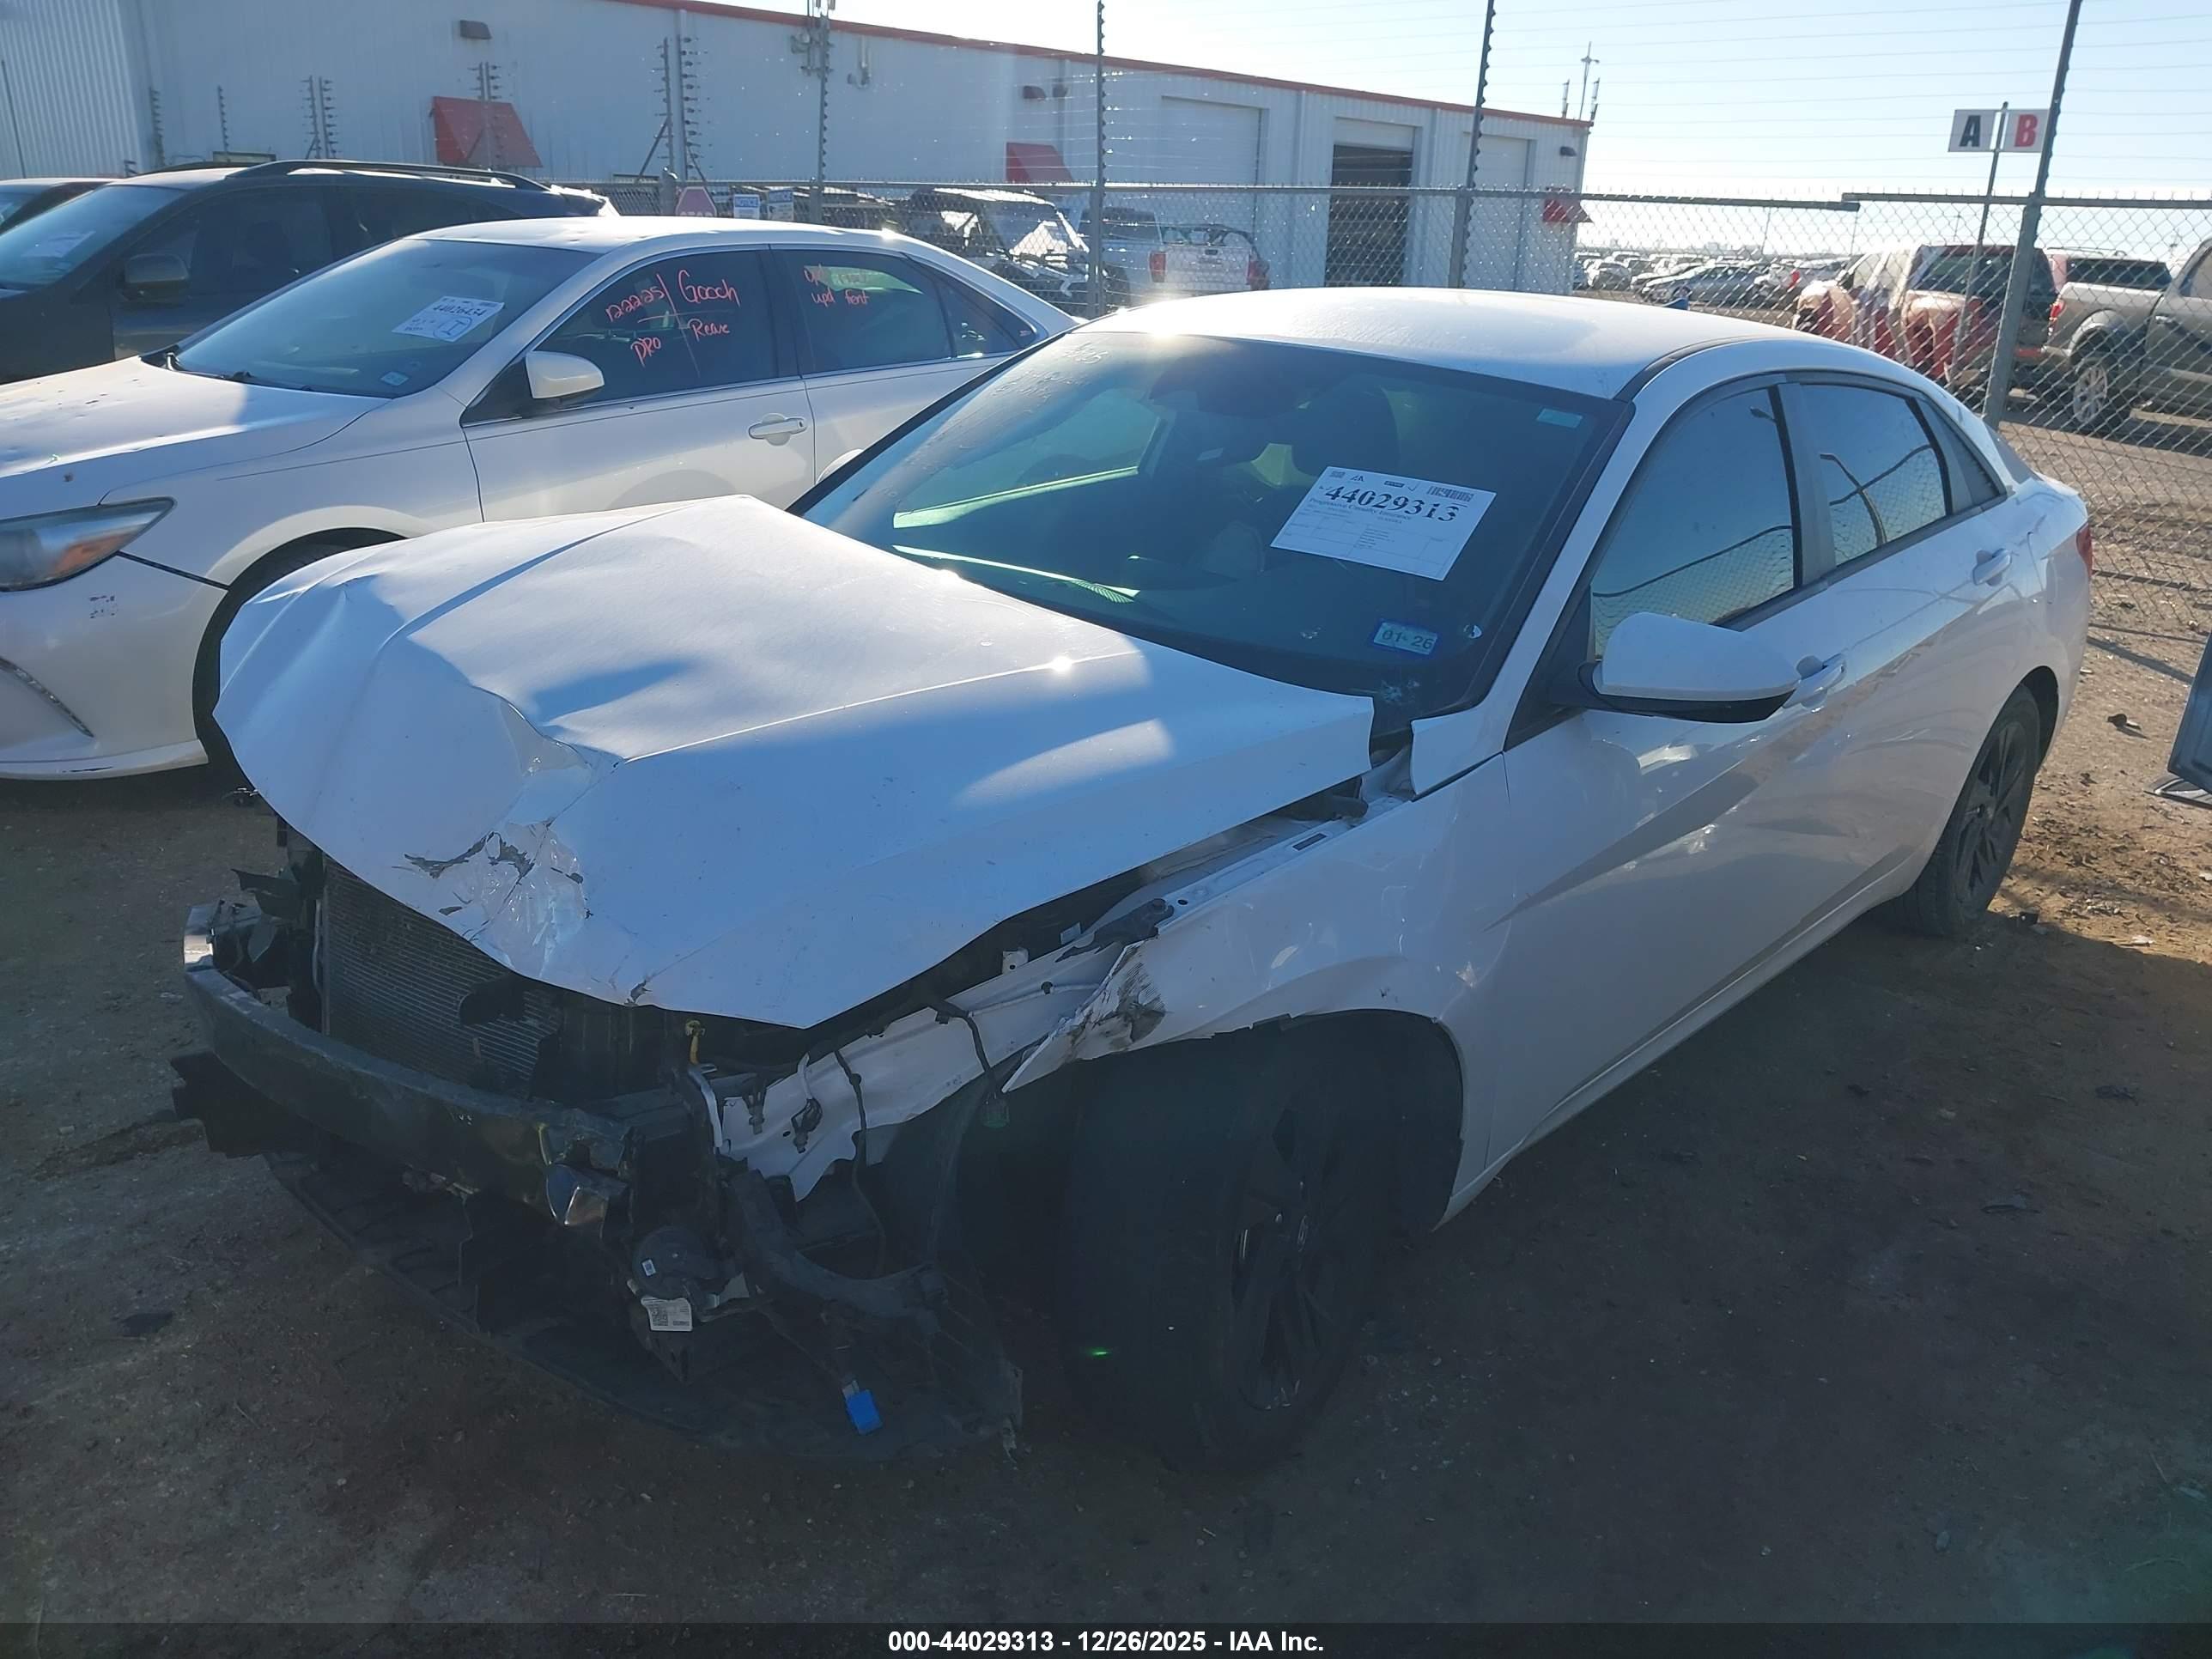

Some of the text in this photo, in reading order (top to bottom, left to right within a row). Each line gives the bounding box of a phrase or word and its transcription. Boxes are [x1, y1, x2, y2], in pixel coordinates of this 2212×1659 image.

[1959, 114, 1981, 148] A
[2014, 113, 2039, 148] B
[678, 269, 741, 307] Gooch
[1325, 485, 1460, 522] 44029313
